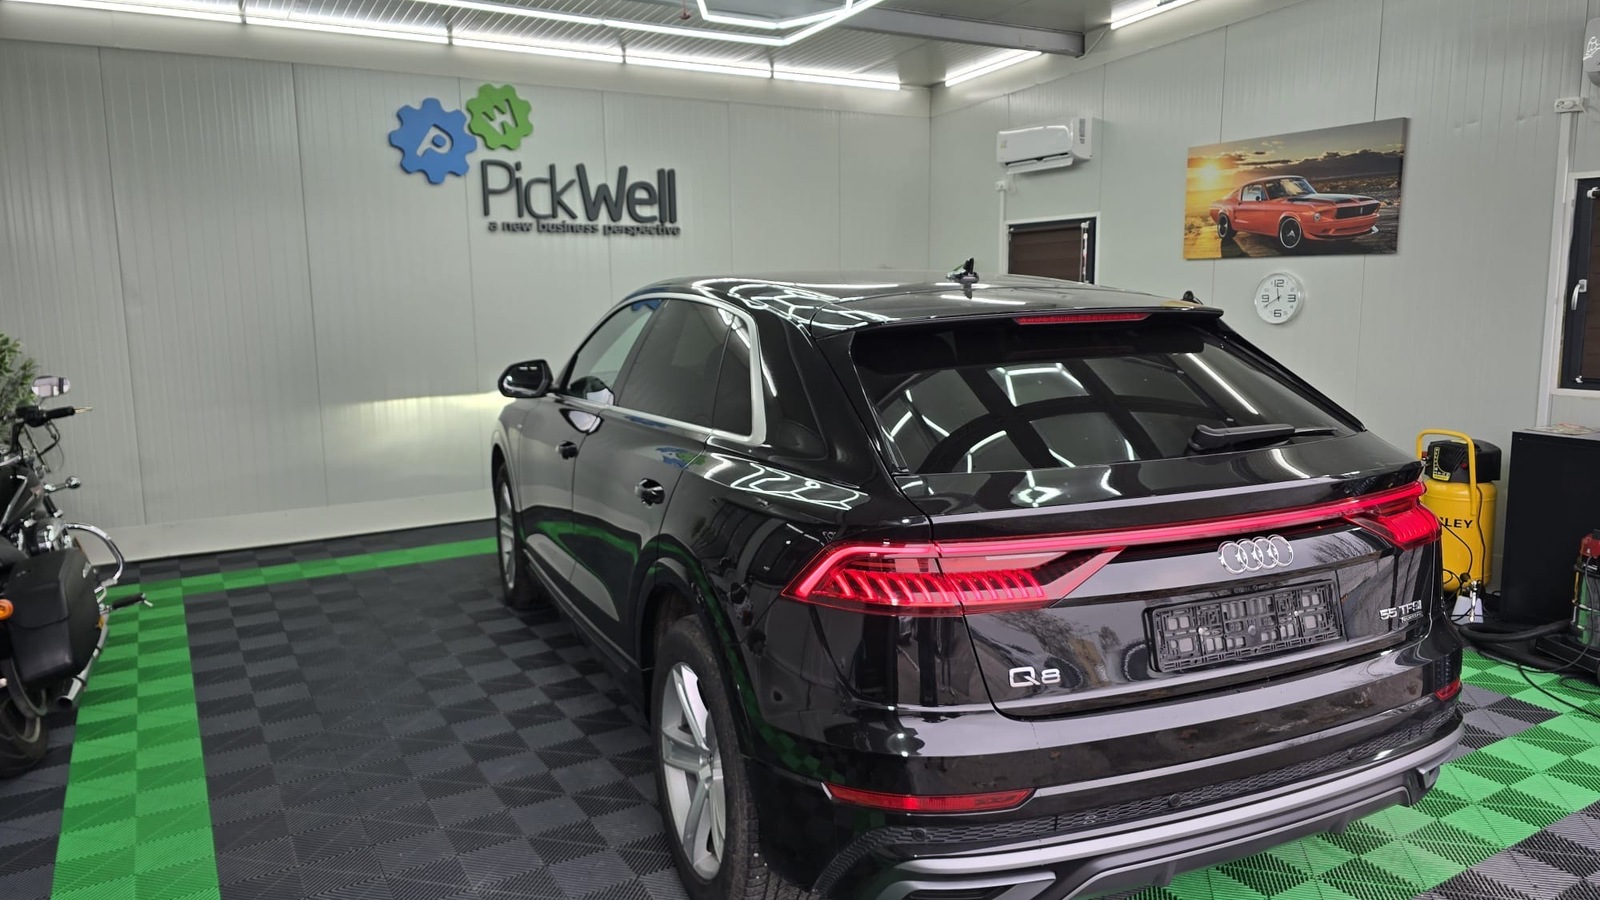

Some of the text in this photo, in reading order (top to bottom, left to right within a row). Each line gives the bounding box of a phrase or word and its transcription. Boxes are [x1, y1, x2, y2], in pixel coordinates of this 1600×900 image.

[481, 98, 519, 136] W
[416, 123, 455, 157] P
[480, 159, 677, 224] PickWell
[488, 219, 681, 236] a new business perspective
[1274, 279, 1285, 287] 12
[1262, 294, 1269, 302] 9
[1288, 294, 1296, 302] 3
[1274, 309, 1282, 317] 6
[1379, 607, 1397, 620] 55
[1009, 666, 1061, 688] Q8
